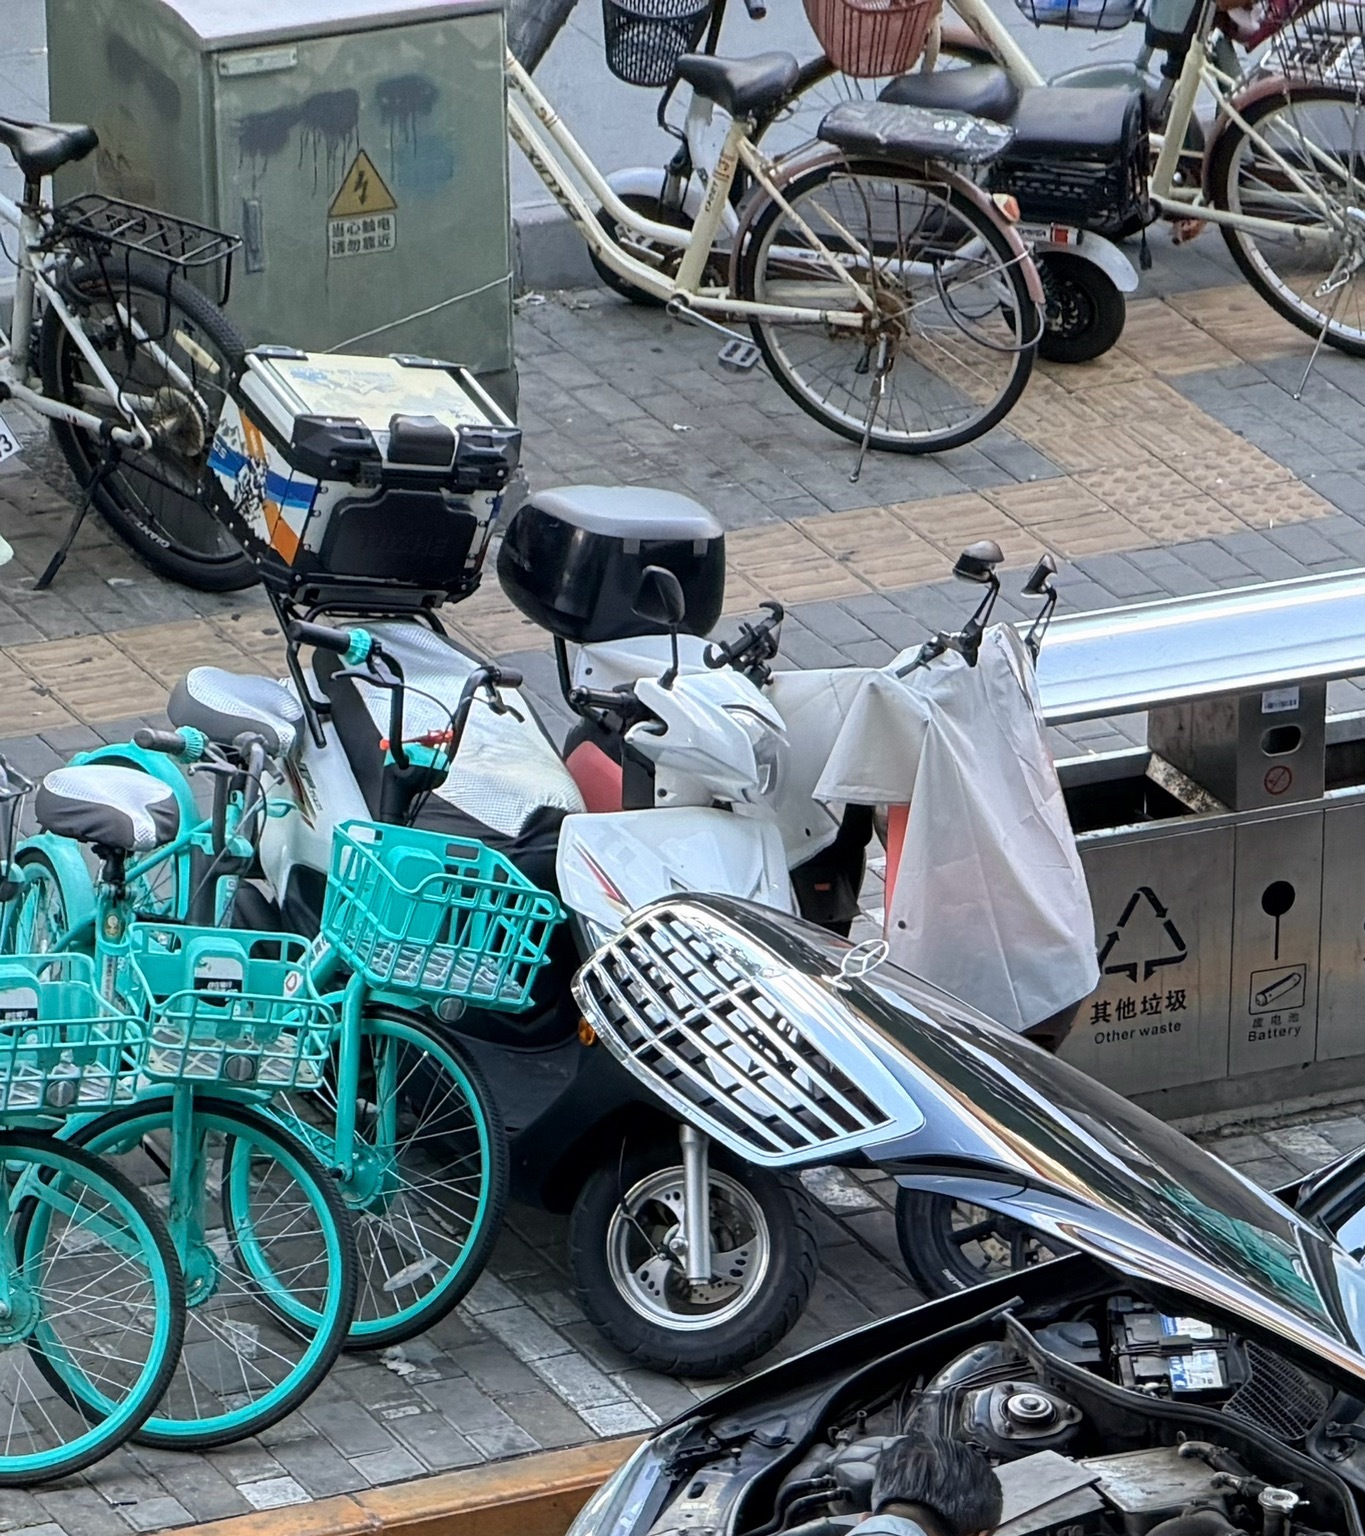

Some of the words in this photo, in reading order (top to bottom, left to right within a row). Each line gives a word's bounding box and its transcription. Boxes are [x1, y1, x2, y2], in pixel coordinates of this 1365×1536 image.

[332, 217, 391, 237] 当心触电
[332, 235, 391, 256] 请勿靠近
[1089, 989, 1188, 1025] 其他垃圾
[1094, 1028, 1136, 1045] Other
[1139, 1020, 1182, 1038] waste
[1248, 1024, 1303, 1043] Battery
